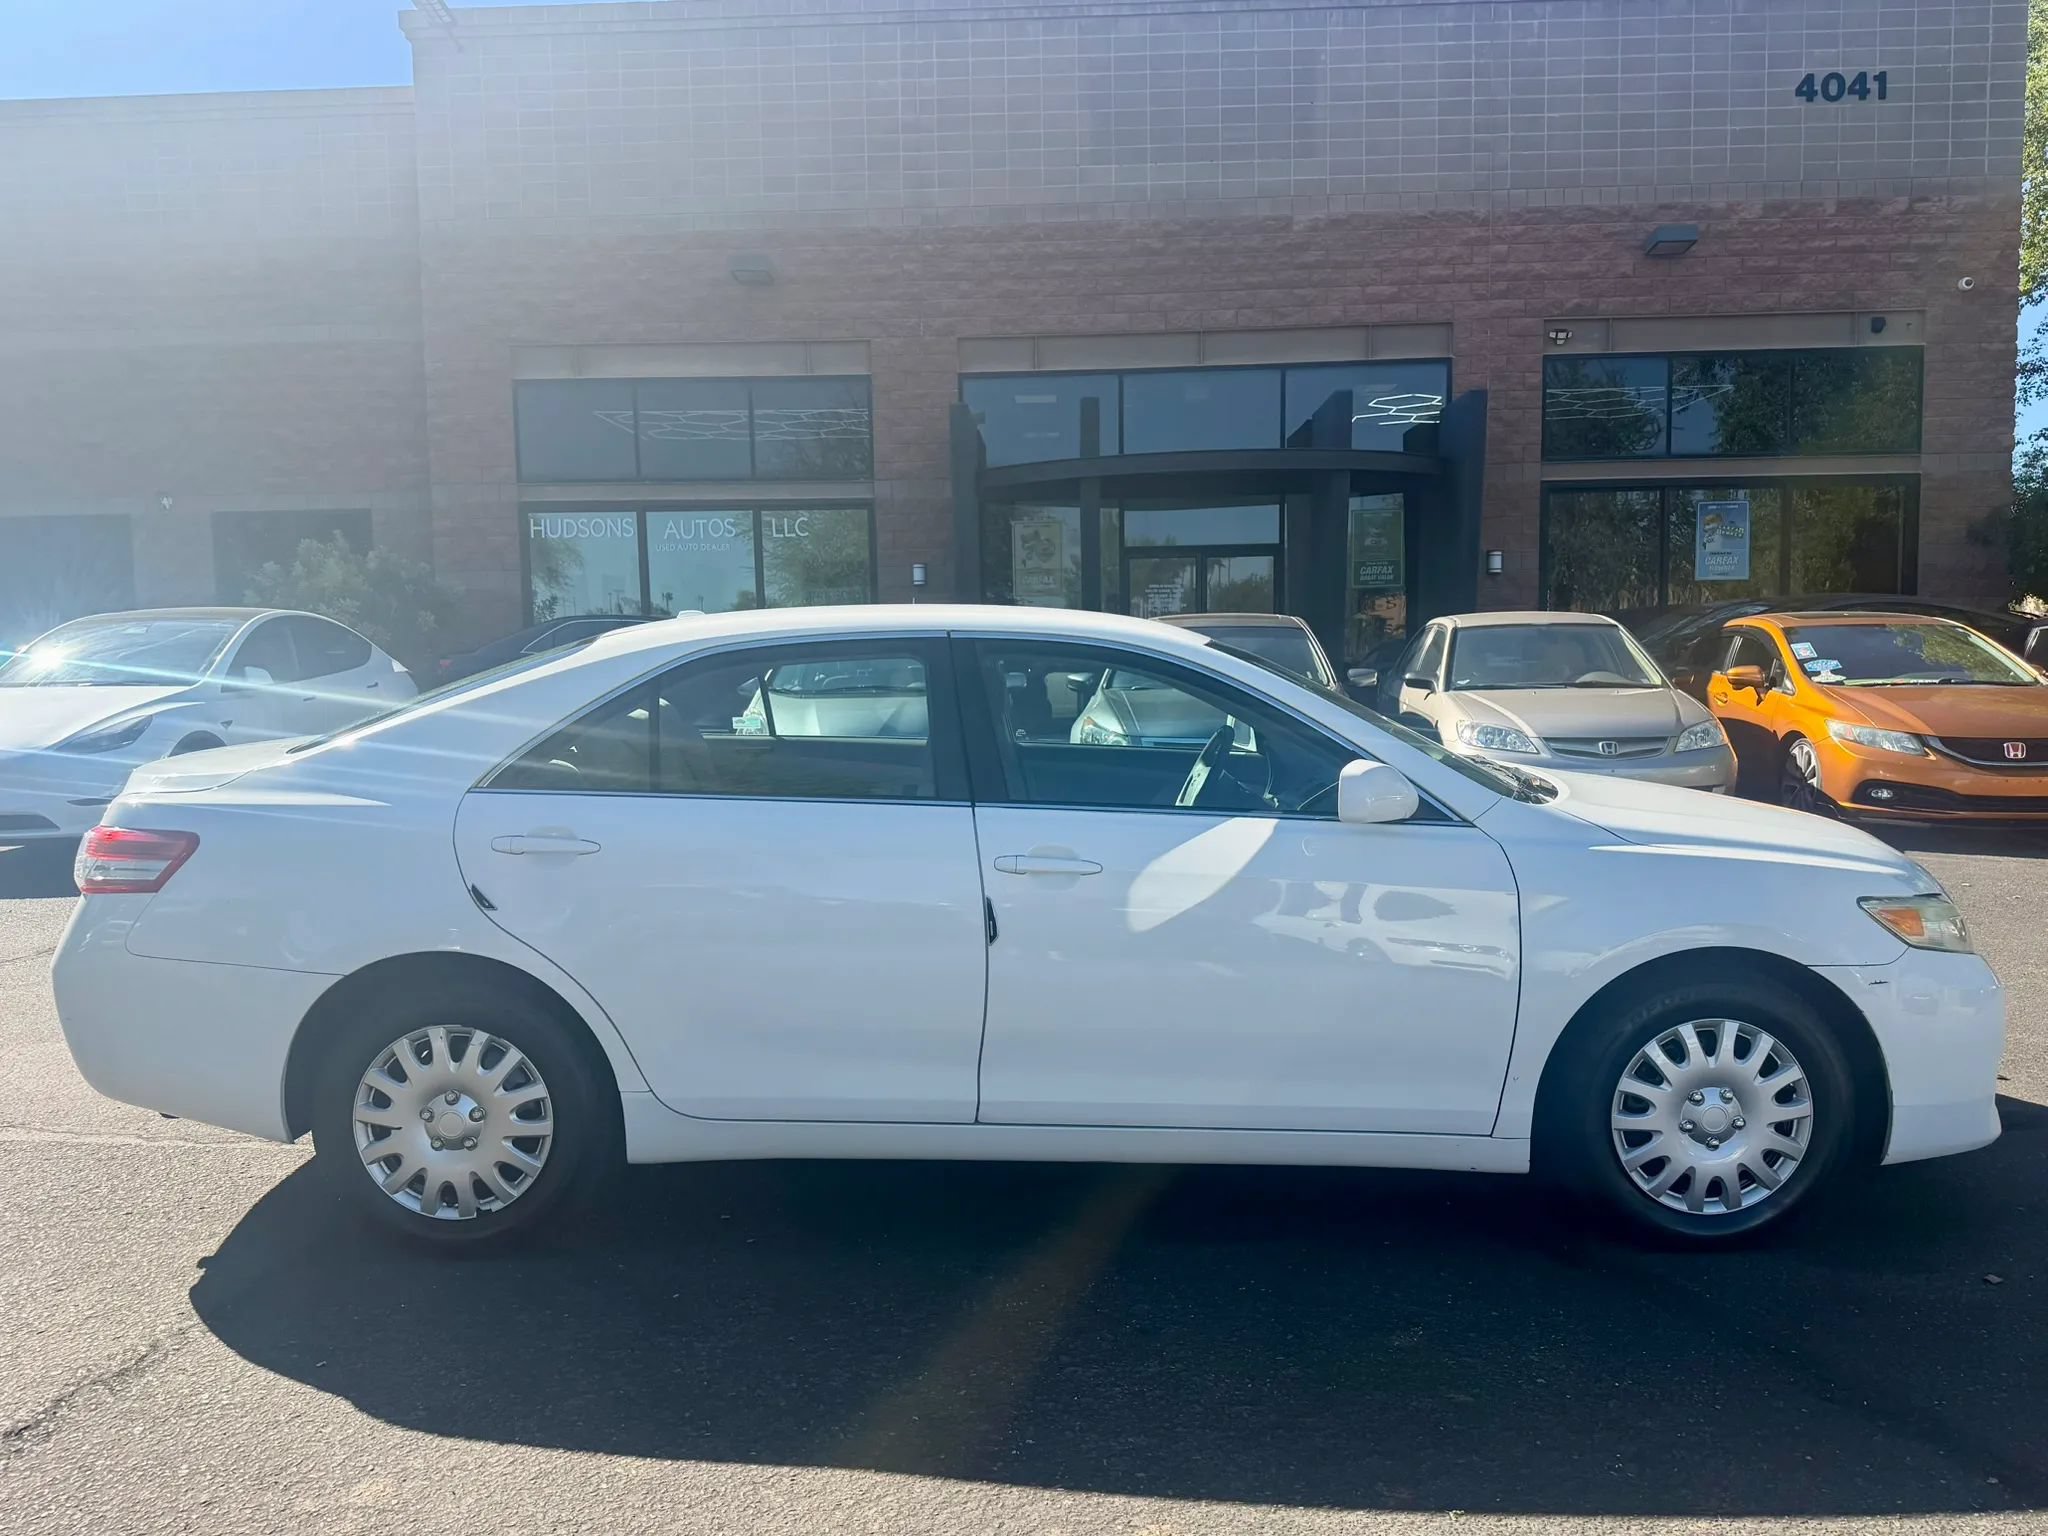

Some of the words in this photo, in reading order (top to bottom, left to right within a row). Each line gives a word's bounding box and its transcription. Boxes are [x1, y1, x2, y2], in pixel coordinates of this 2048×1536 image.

[1795, 71, 1887, 102] 4041
[530, 518, 634, 539] HUDSONS
[663, 518, 736, 539] AUTOS
[772, 517, 809, 537] LLC
[677, 544, 699, 552] AUTO
[1360, 565, 1394, 575] CARFAX
